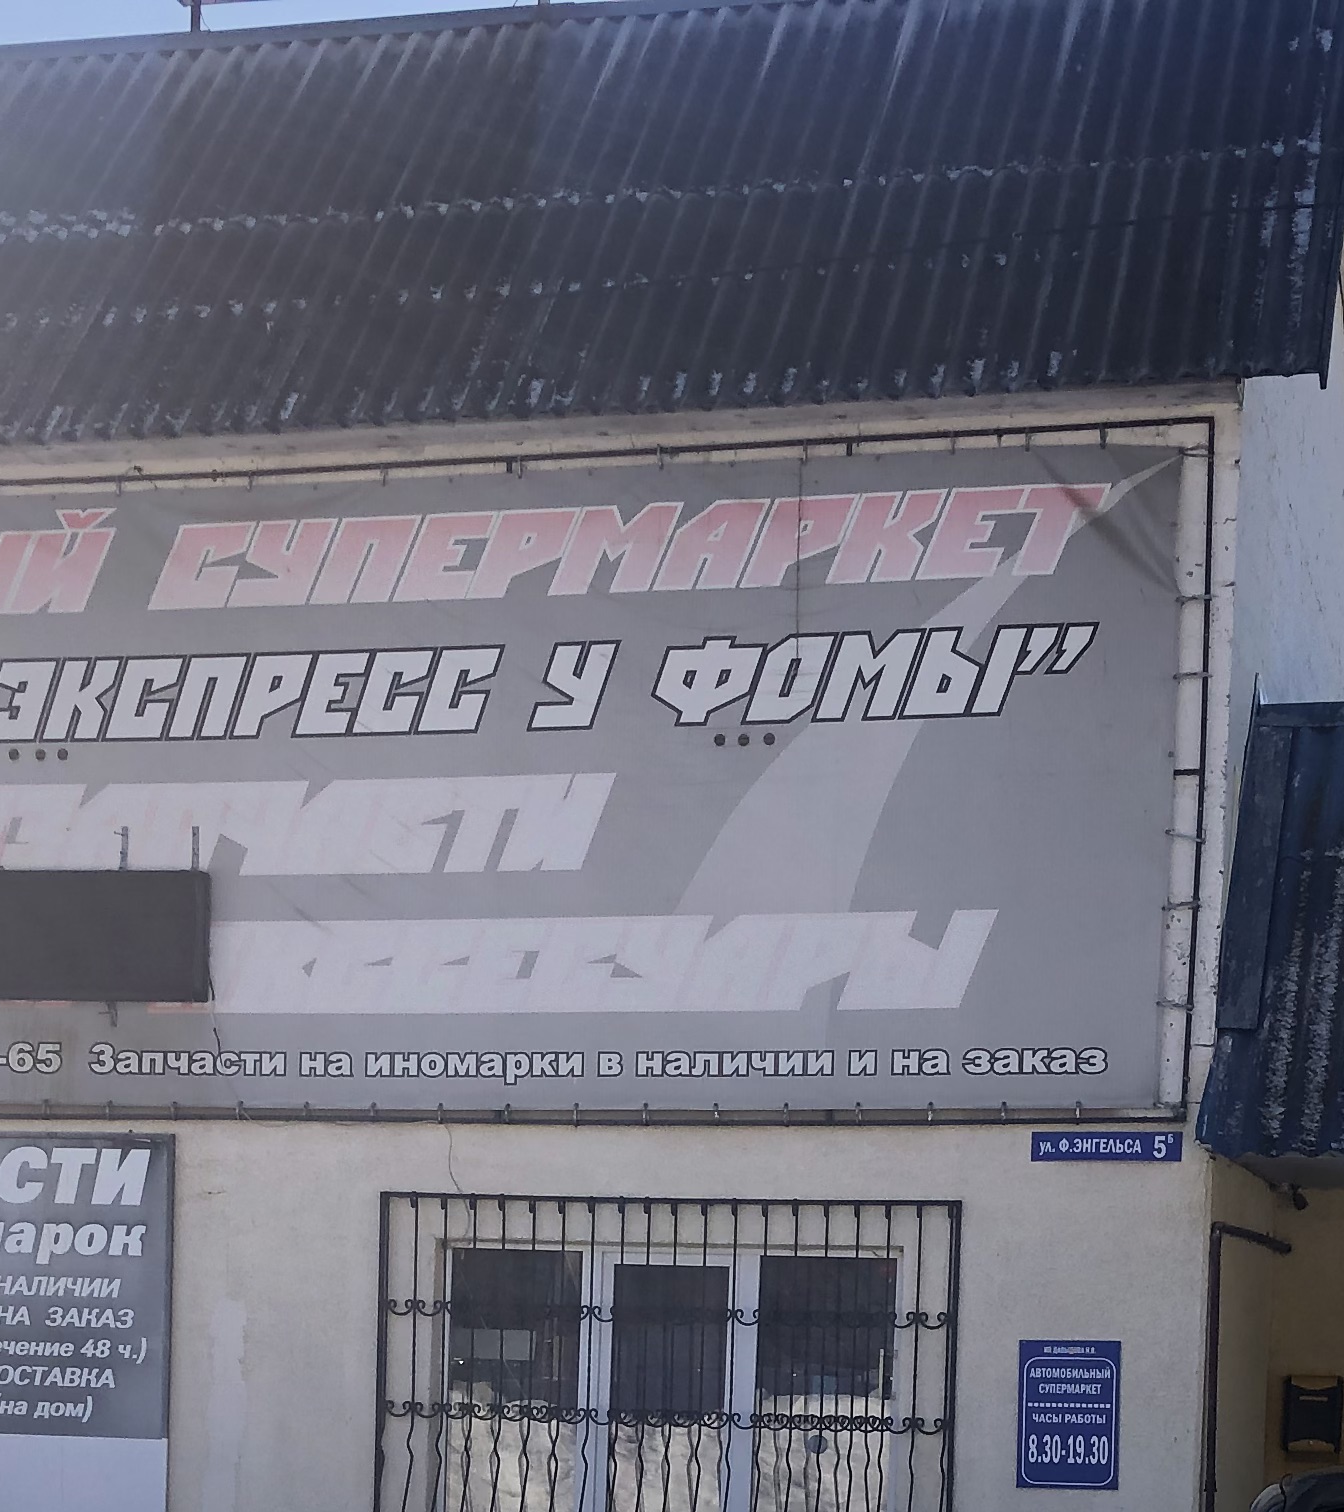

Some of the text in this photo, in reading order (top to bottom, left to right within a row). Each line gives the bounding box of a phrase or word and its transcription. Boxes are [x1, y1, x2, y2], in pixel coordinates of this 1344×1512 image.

[148, 483, 1112, 611] СУПЕРМАРКЕТ
[527, 640, 621, 731] У
[88, 1042, 287, 1078] Запчасти
[299, 1050, 355, 1078] на
[365, 1050, 585, 1085] иномарки
[596, 1050, 623, 1078] в
[635, 1049, 836, 1078] наличии
[847, 1048, 878, 1076] и
[890, 1047, 951, 1076] на
[962, 1045, 1109, 1076] заказ
[44, 1307, 135, 1329] ЗАКАЗ
[80, 1339, 112, 1359] 48
[1029, 1367, 1111, 1379] АВТОМОБИЛЬНЫЙ
[1038, 1384, 1102, 1394] СУПЕРМАРКЕТ
[1032, 1413, 1107, 1424] ЧАСЫ РАБОТЫ
[1028, 1434, 1109, 1464] 8.30-19.30
